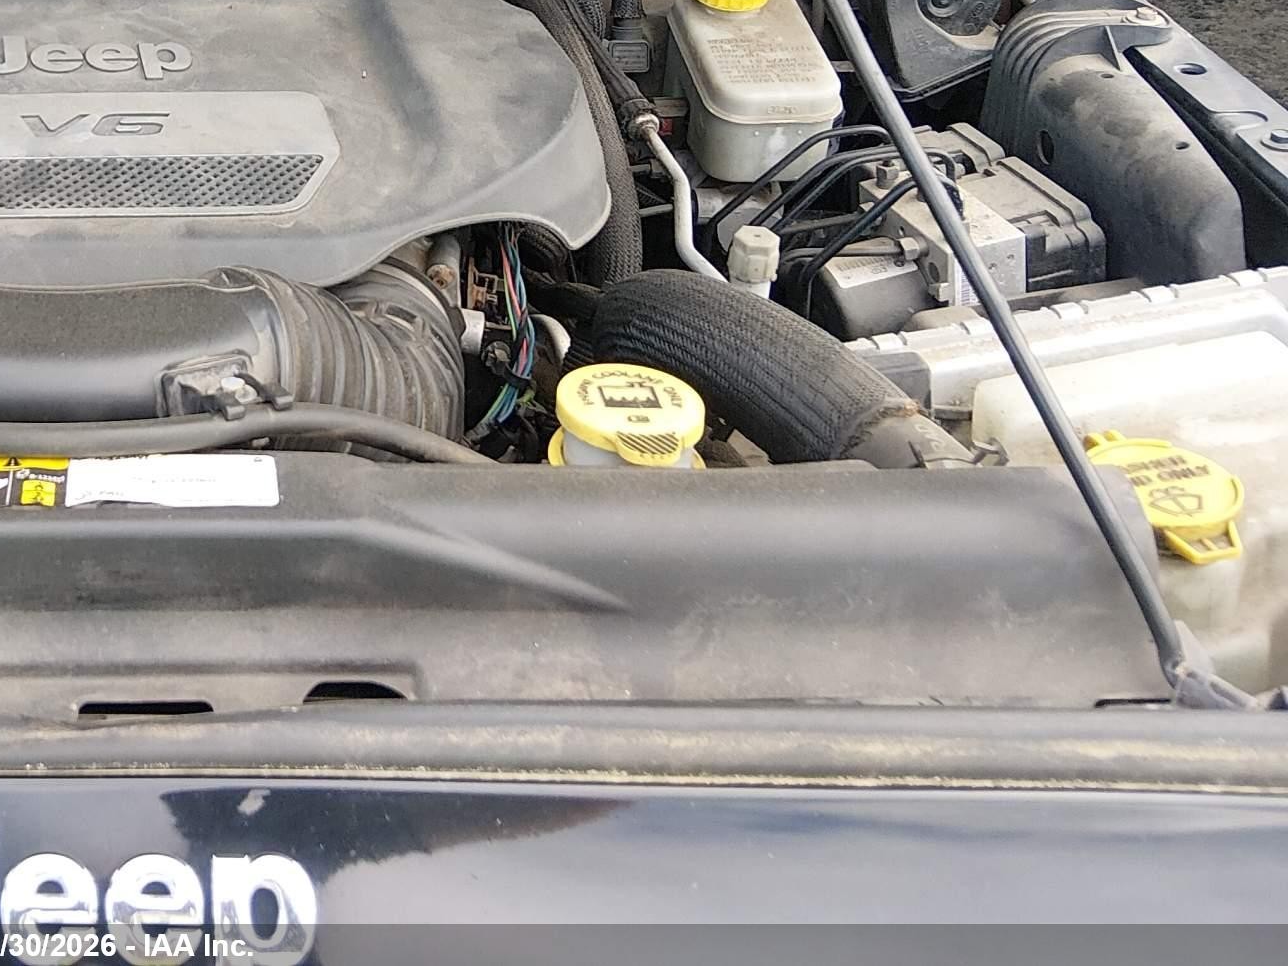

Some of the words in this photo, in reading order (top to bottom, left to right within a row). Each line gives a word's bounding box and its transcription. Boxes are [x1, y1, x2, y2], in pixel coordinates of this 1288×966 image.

[20, 113, 170, 136] V6
[592, 370, 663, 384] COOLANT
[663, 386, 683, 409] ONLY
[1157, 465, 1210, 482] ONLY
